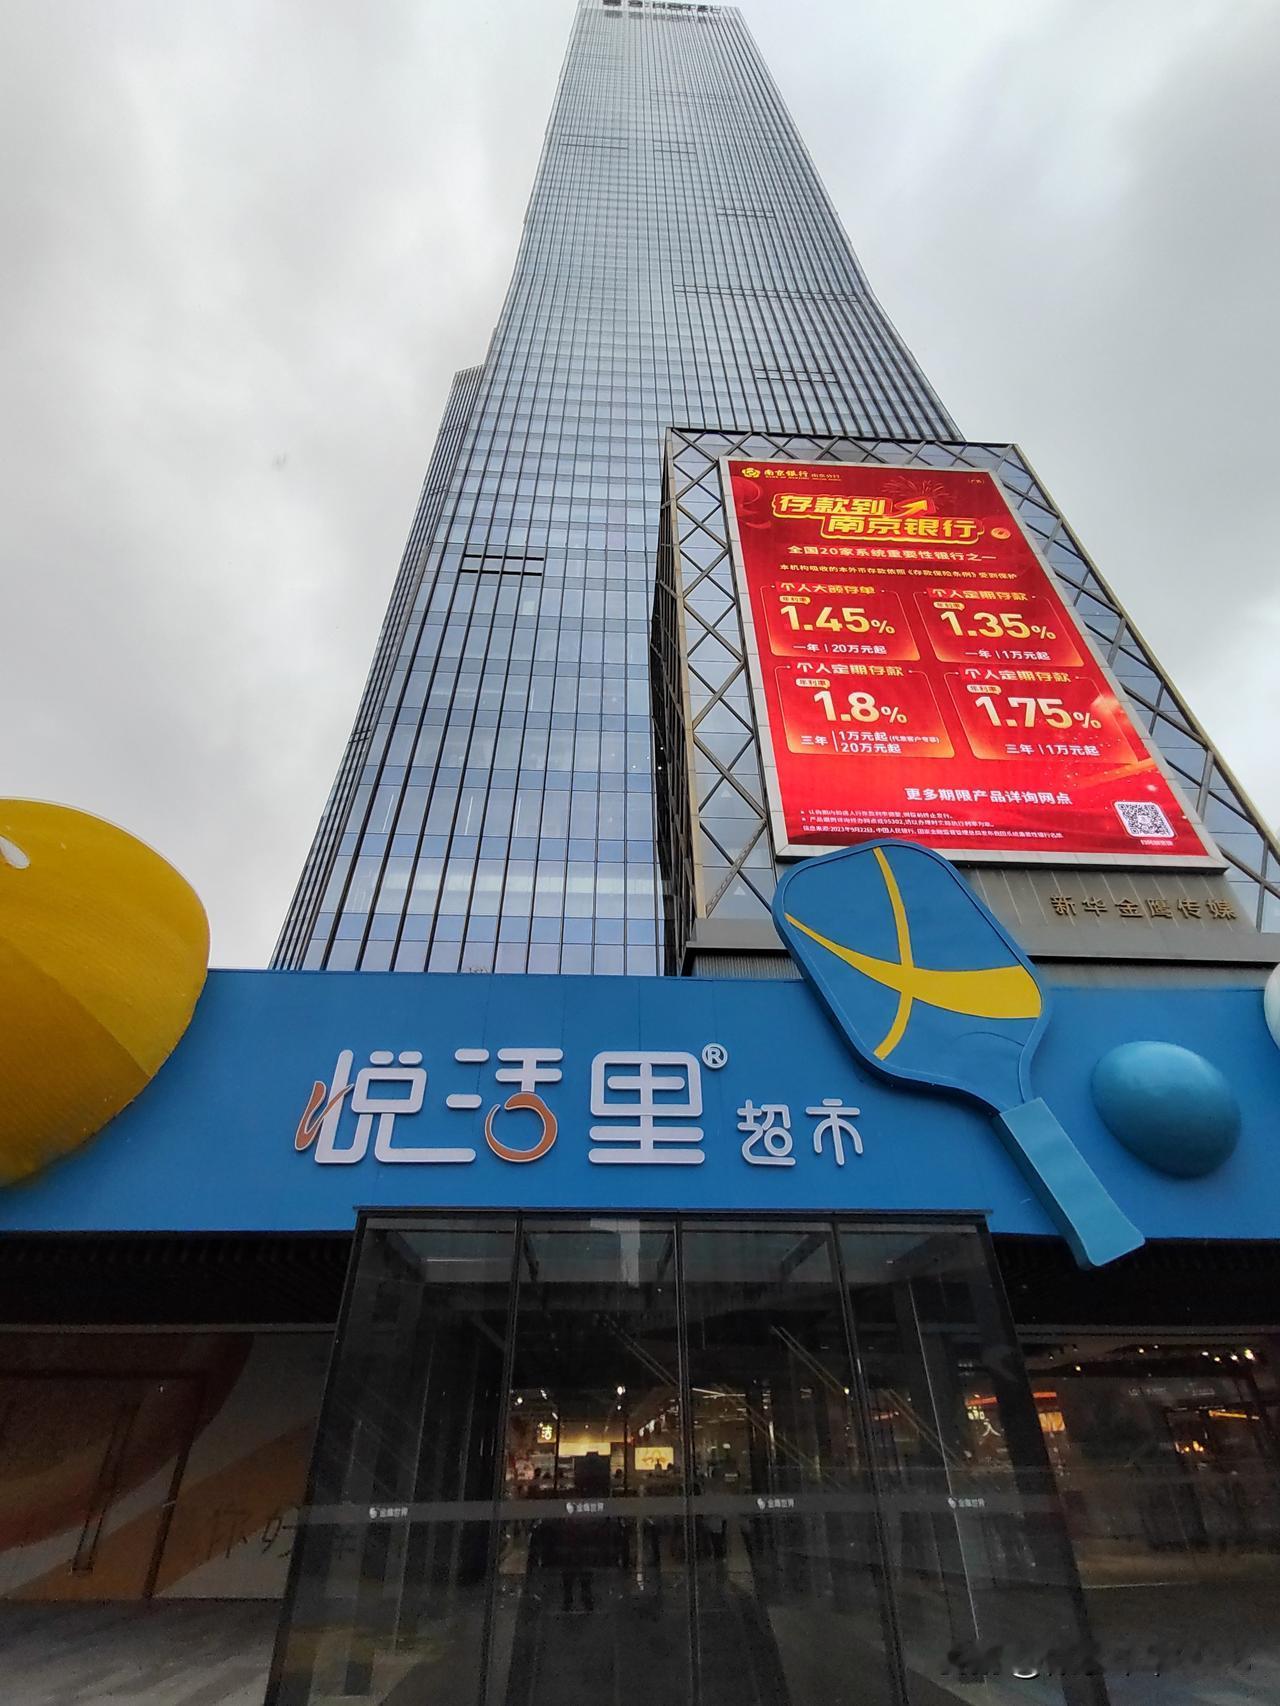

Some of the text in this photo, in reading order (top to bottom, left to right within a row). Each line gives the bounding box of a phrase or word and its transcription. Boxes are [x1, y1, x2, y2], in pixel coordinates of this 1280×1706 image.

[779, 495, 886, 515] 存款到
[828, 515, 977, 538] 南京银行
[787, 545, 997, 562] 全国20家系统重要性银行之一
[780, 582, 876, 594] 个人大额存单
[932, 588, 1028, 600] 个人定期存款
[780, 605, 896, 634] 1.45%
[940, 611, 1057, 639] 1.35%
[797, 662, 904, 676] 个人定期存款
[965, 668, 1071, 682] 个人定期存款
[813, 690, 908, 723] 1.8%
[975, 696, 1101, 729] 1.75%
[904, 788, 1073, 804] 更多期限产品详询网点
[295, 1048, 705, 1165] 悦活里
[737, 1099, 864, 1167] 超市
